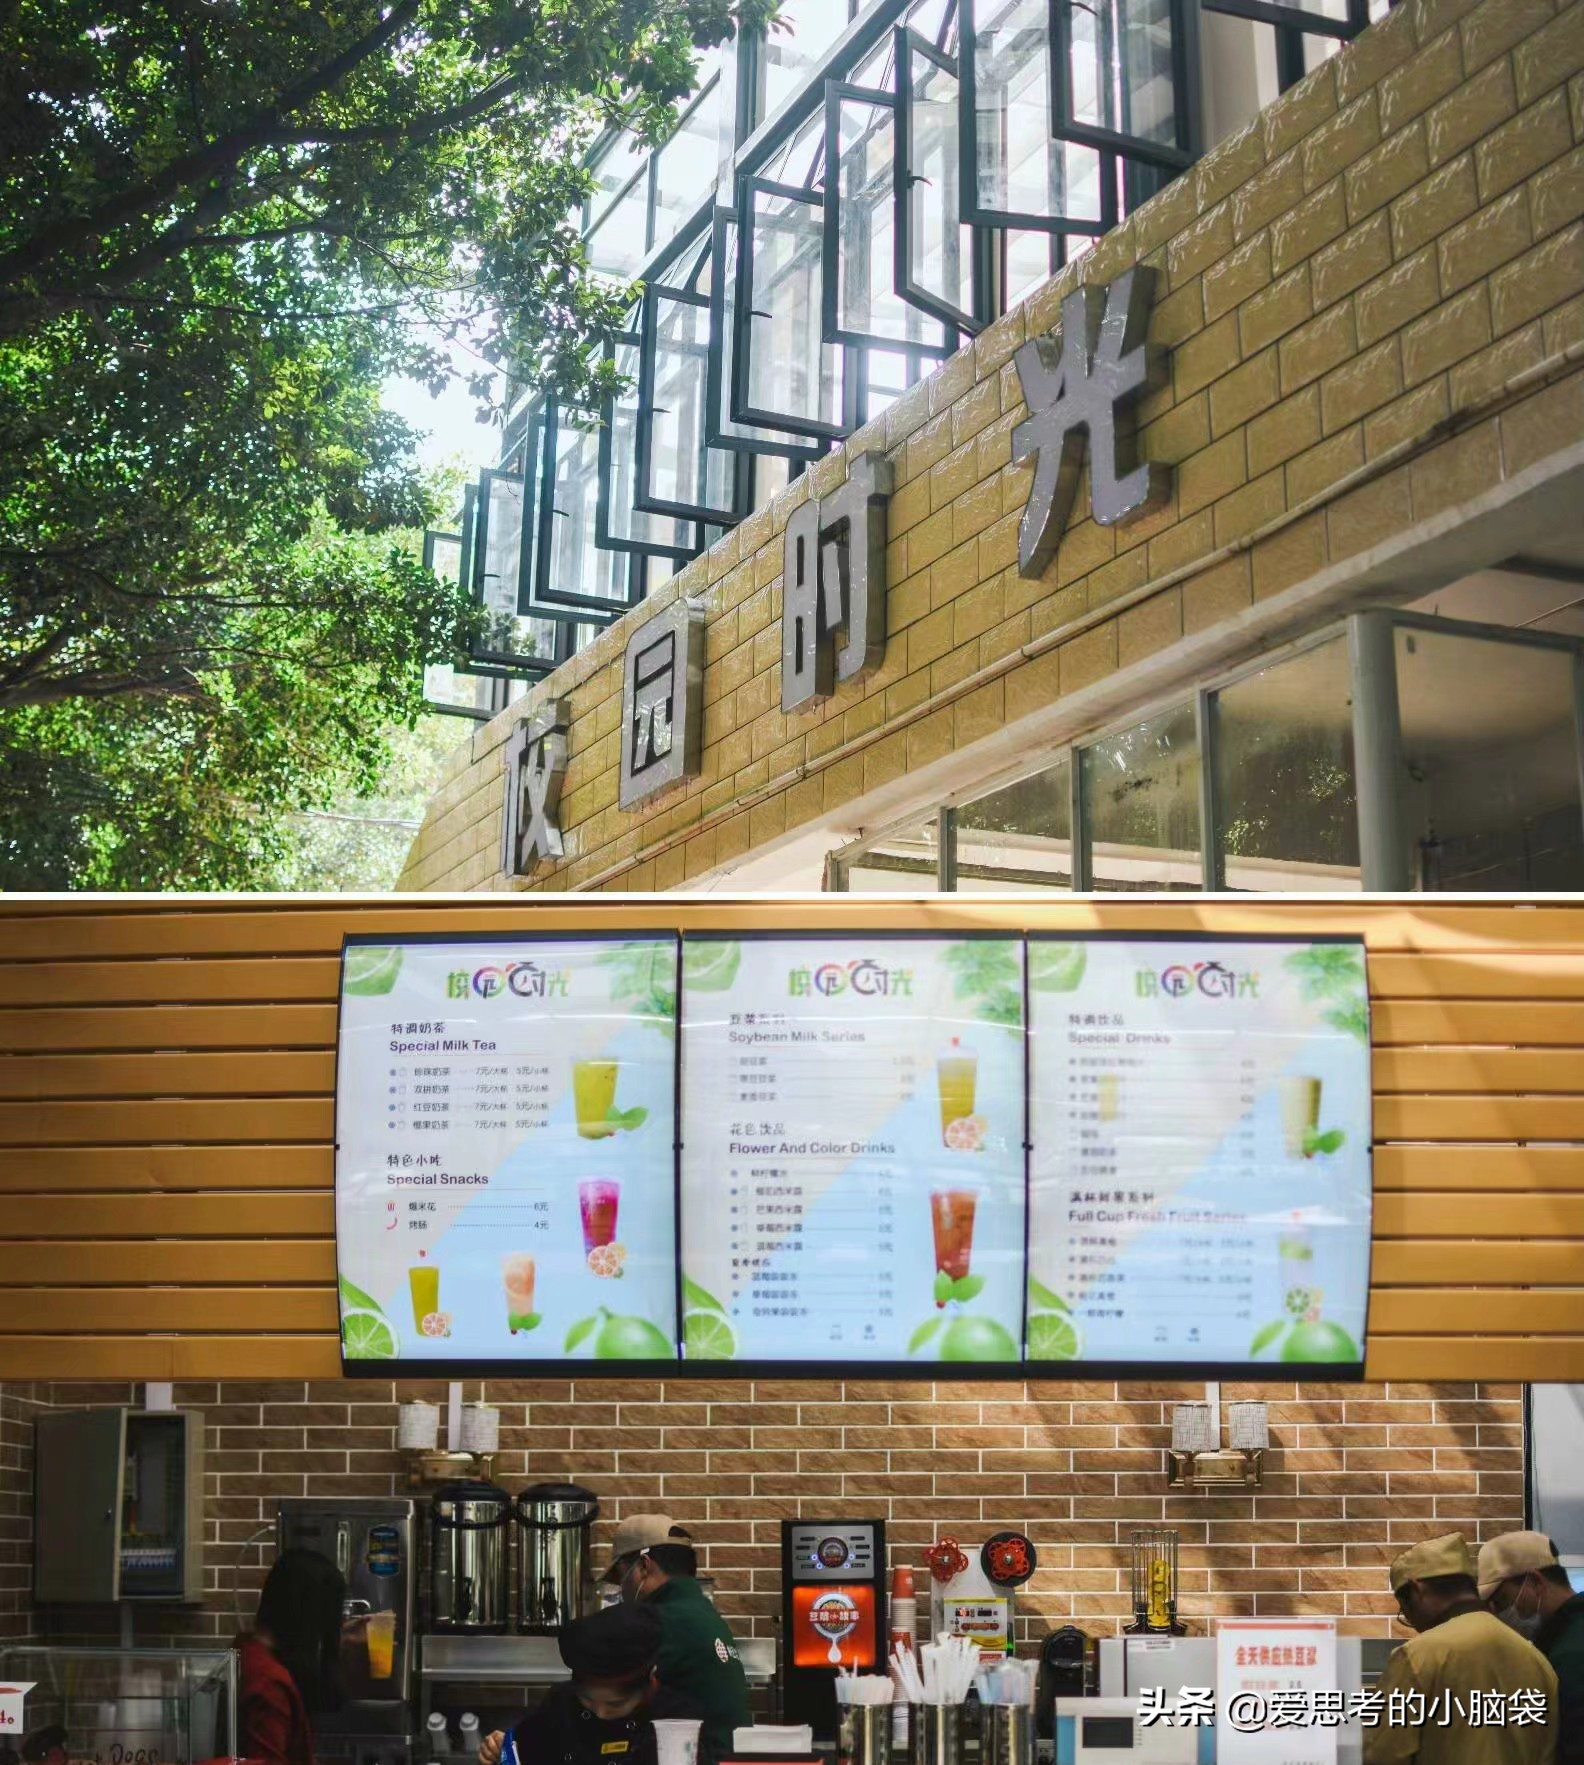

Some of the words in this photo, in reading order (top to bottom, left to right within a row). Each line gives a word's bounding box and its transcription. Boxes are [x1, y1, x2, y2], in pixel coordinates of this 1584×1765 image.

[390, 1021, 446, 1035] 特调奶茶
[728, 1031, 788, 1045] Soybean
[791, 1031, 818, 1042] Milk
[821, 1031, 866, 1042] Series
[1068, 1032, 1120, 1045] Special
[1125, 1032, 1172, 1044] Drinks
[390, 1039, 440, 1055] Special
[442, 1039, 470, 1052] Milk
[473, 1039, 497, 1051] Tea
[413, 1102, 449, 1112] 红豆奶茶
[729, 1123, 786, 1136] 花色饮品
[729, 1141, 776, 1154] Flower
[779, 1141, 807, 1153] And
[809, 1141, 847, 1154] Color
[850, 1141, 896, 1154] Drinks
[387, 1153, 443, 1168] 特色小吃
[387, 1173, 437, 1188] Special
[440, 1173, 489, 1185] Snacks
[1068, 1210, 1093, 1222] Full
[1096, 1210, 1125, 1224] Cup
[408, 1219, 428, 1230] 烤肠
[533, 1220, 549, 1230] 4元
